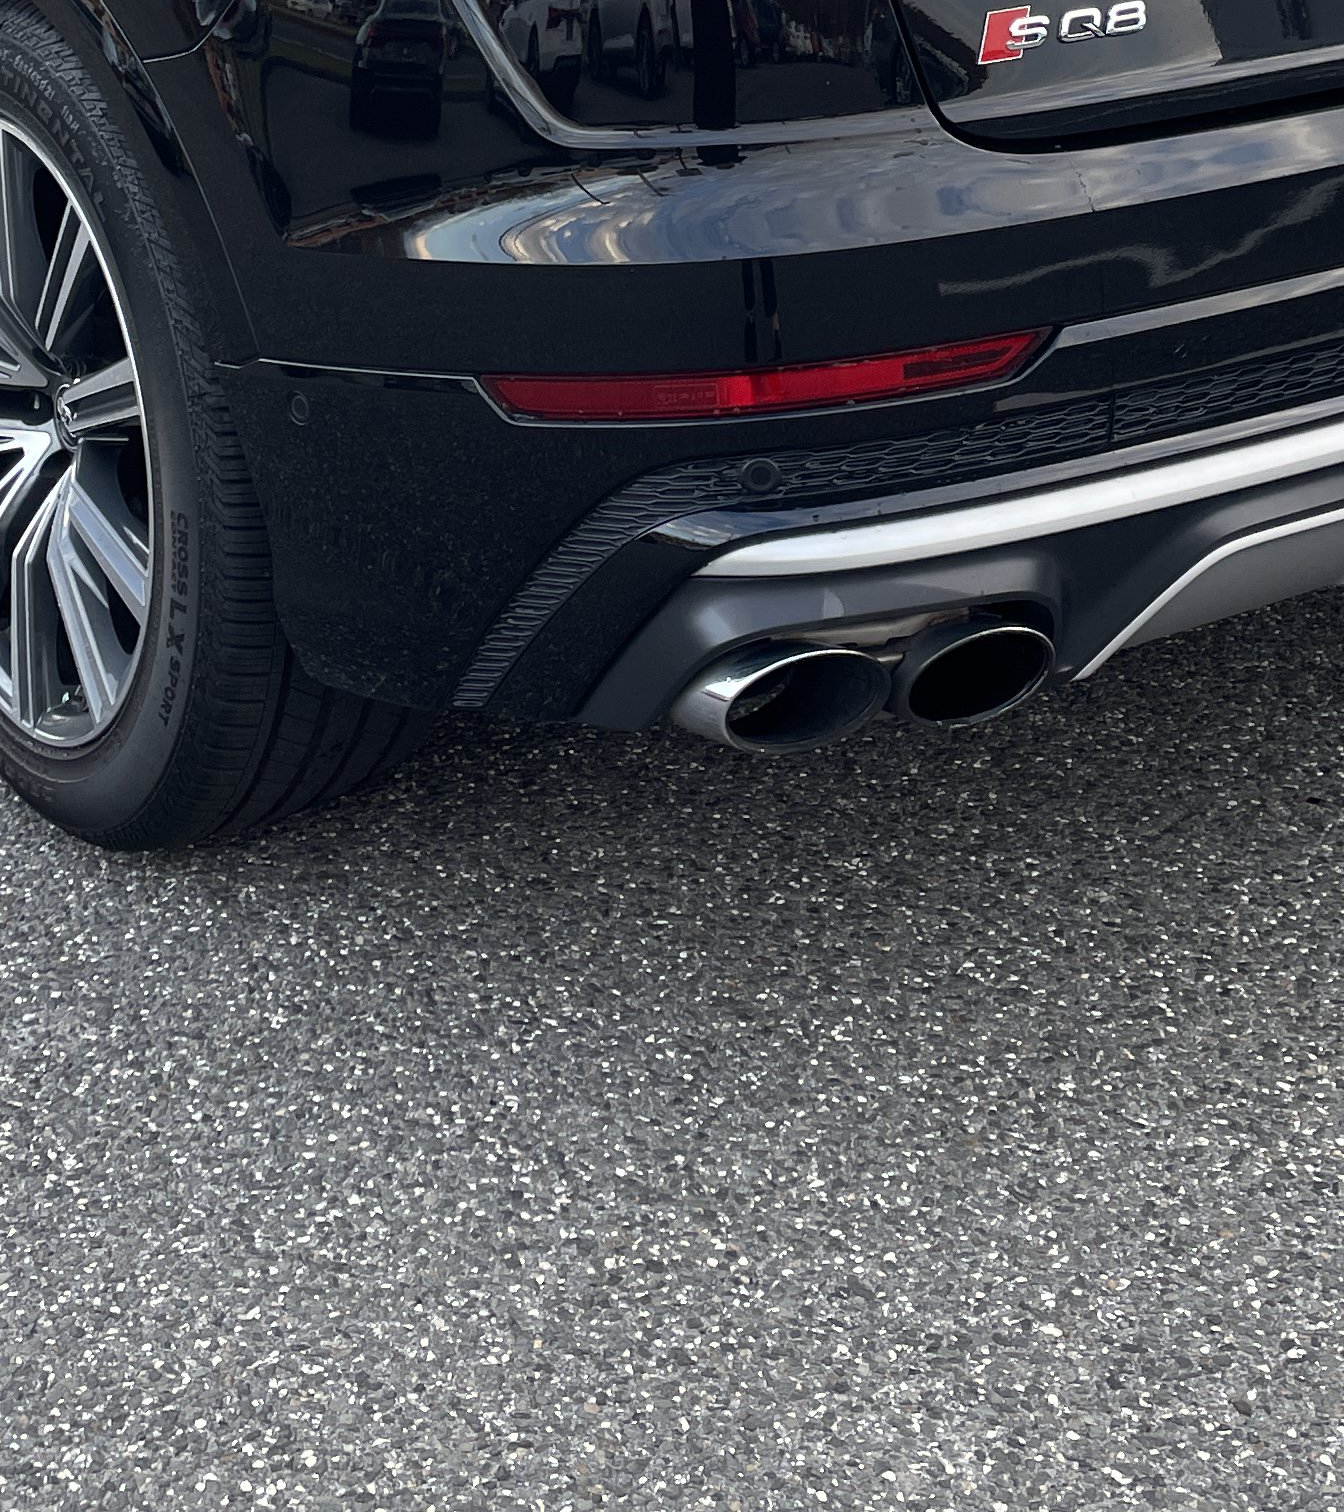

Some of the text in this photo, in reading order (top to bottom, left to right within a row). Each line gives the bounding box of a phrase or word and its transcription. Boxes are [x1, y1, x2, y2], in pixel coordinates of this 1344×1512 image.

[1006, 0, 1147, 51] SQ8
[176, 512, 190, 598] CROSS
[157, 654, 182, 728] SPORT
